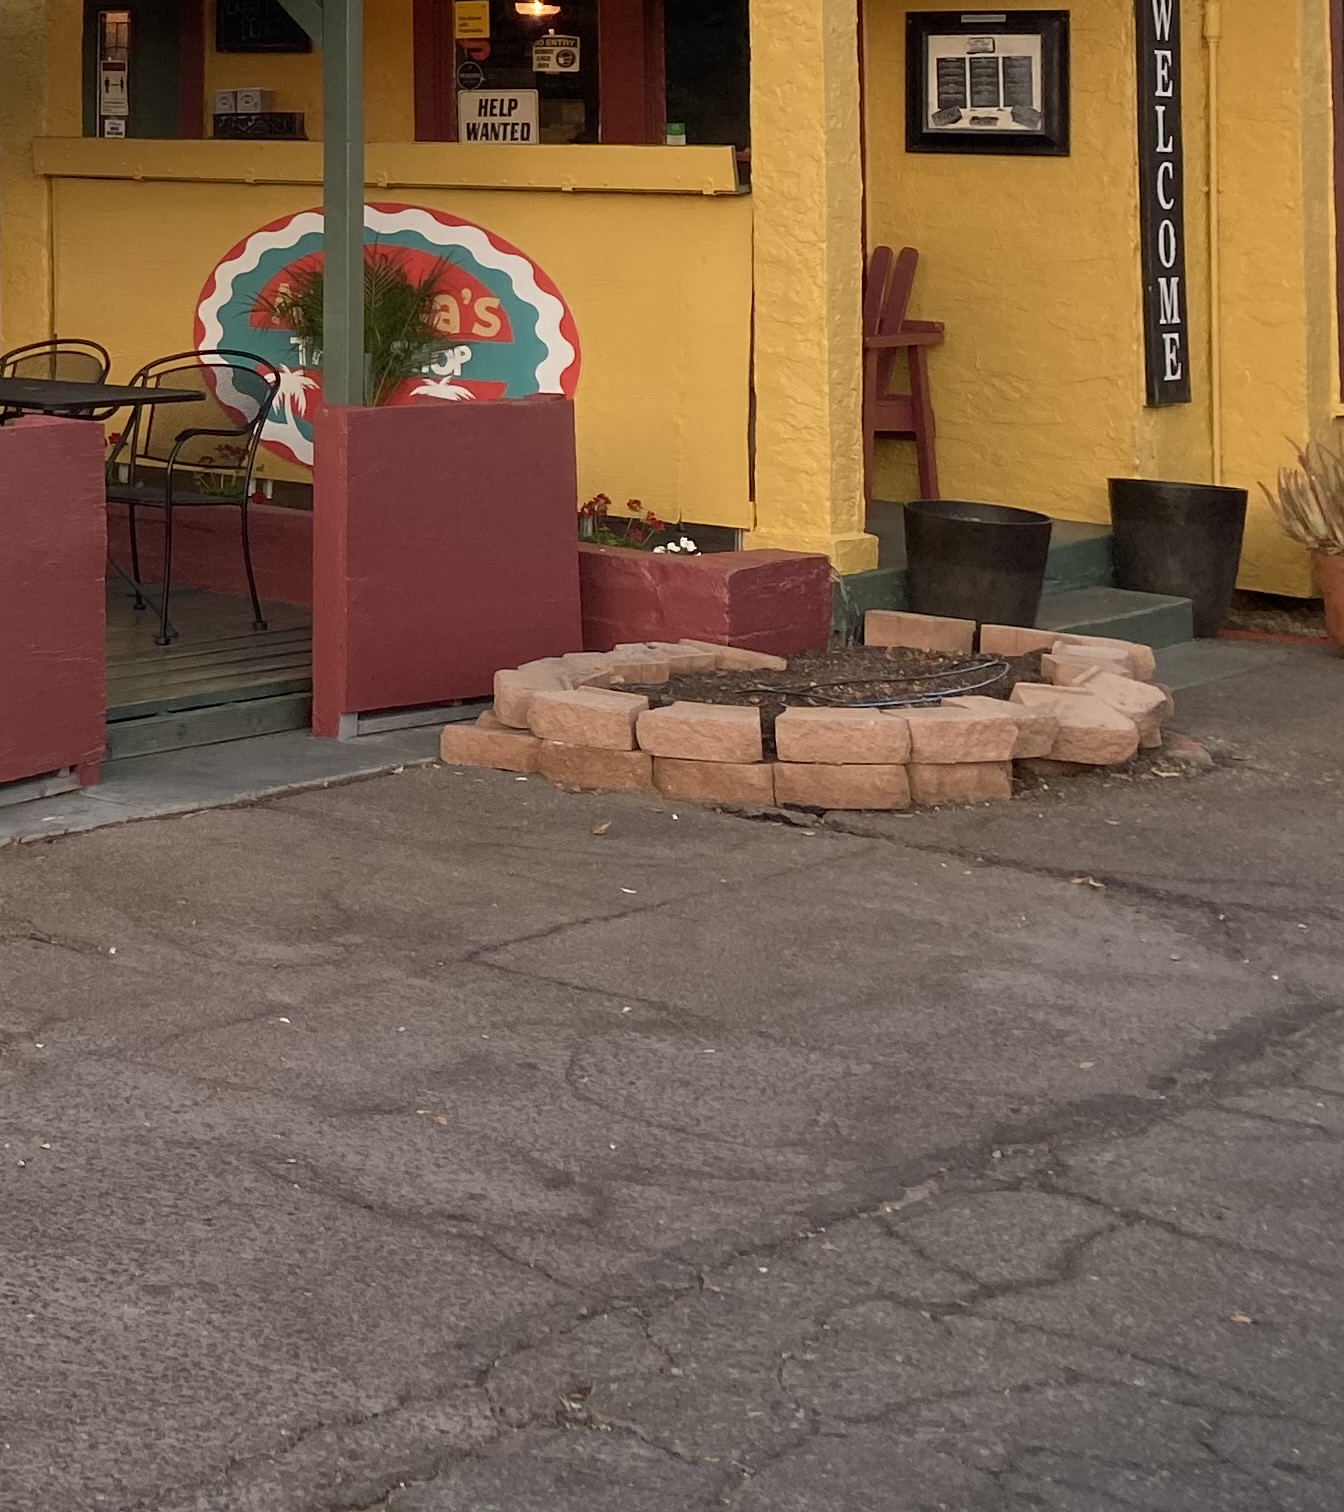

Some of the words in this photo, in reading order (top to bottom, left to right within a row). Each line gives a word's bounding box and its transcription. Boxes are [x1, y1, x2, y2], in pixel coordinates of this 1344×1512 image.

[546, 39, 576, 48] ENTRY
[478, 98, 519, 118] HELP
[466, 122, 531, 142] WANTED
